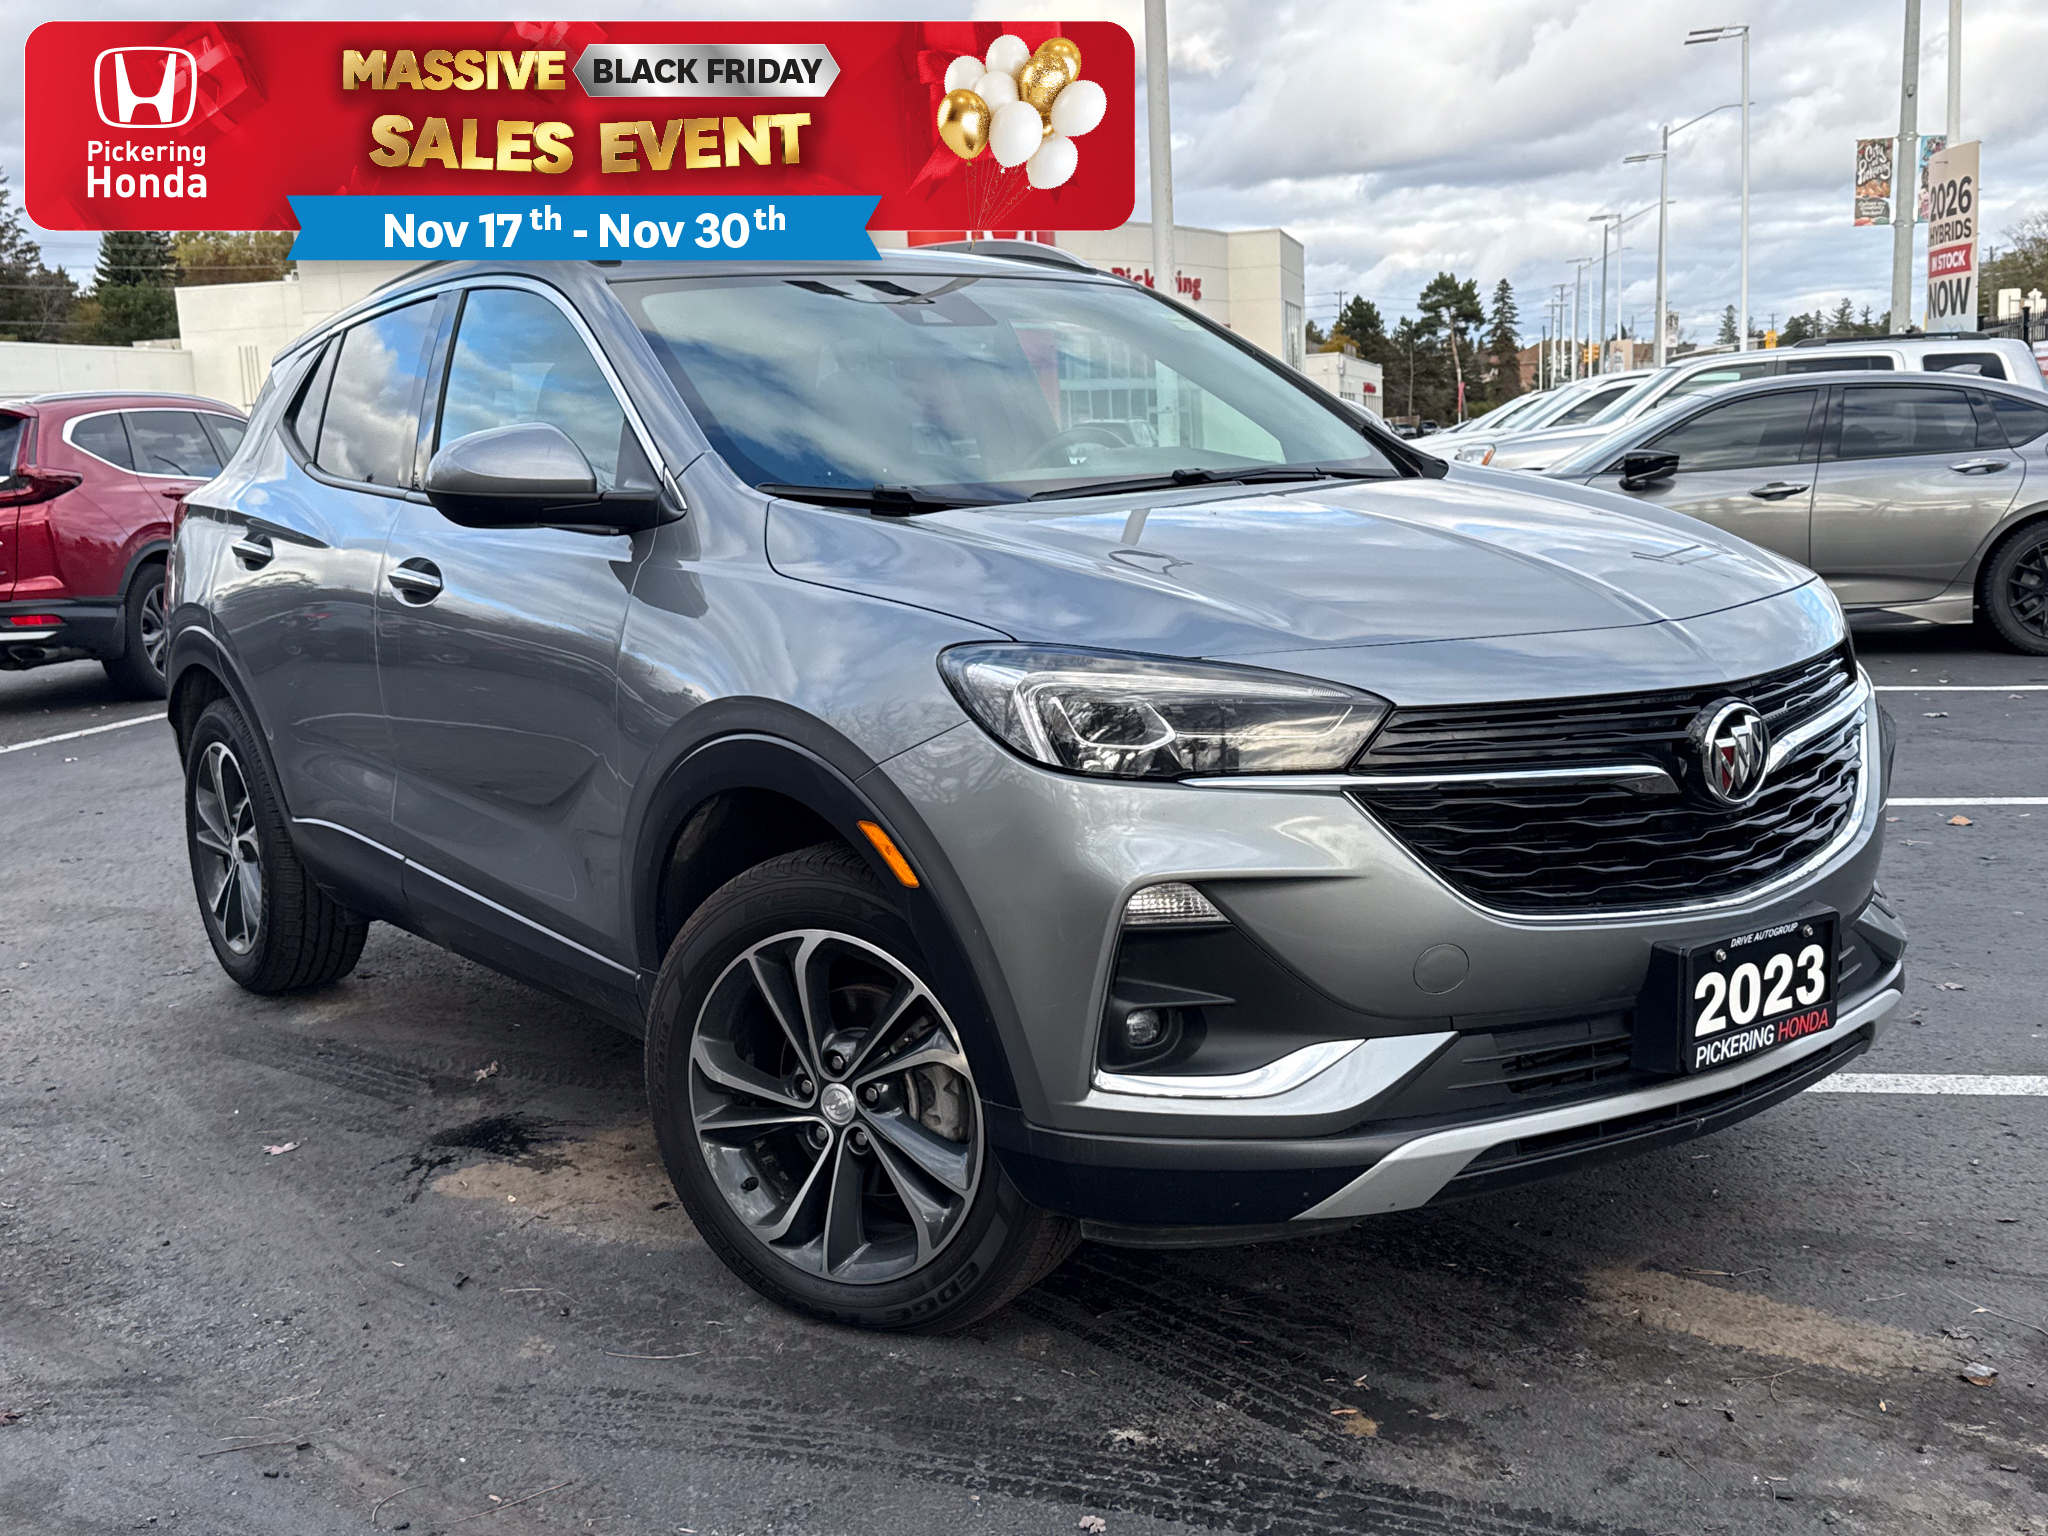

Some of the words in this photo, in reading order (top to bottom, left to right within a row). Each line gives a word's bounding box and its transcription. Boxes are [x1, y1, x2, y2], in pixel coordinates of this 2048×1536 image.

[1865, 143, 1887, 163] City
[1930, 176, 1972, 222] 2026
[1930, 217, 1972, 246] HYBRIDS
[1931, 255, 1938, 272] IN
[1938, 250, 1966, 269] STOCK
[1928, 277, 1971, 319] NOW
[1730, 933, 1754, 948] DRIVE
[1754, 922, 1798, 942] AUTOGROUP
[1694, 944, 1825, 1038] 2023
[1696, 1024, 1775, 1069] PICKERING
[1778, 1008, 1829, 1042] HONDA
